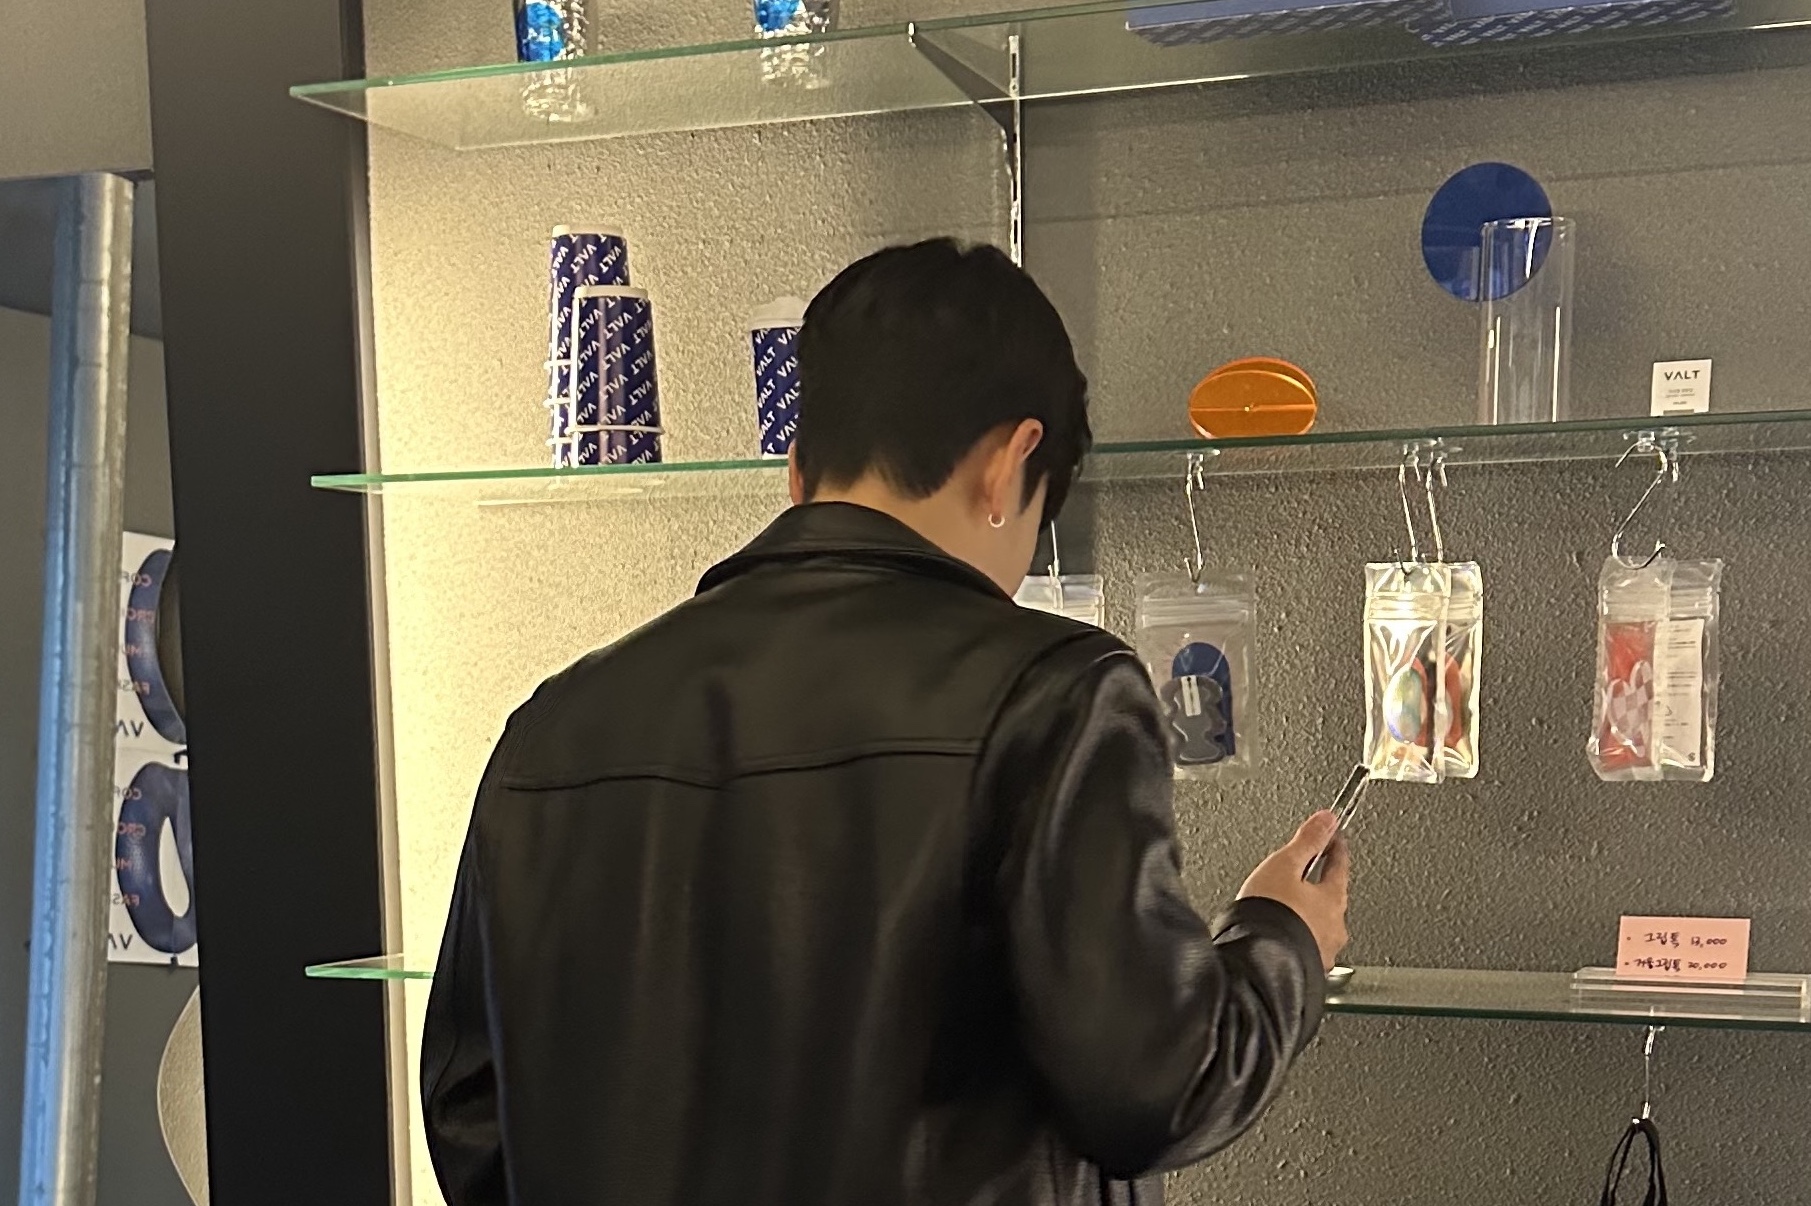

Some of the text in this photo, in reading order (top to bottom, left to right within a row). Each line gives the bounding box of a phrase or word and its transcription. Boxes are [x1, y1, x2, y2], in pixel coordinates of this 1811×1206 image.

[570, 243, 598, 274] VALT
[599, 245, 622, 273] VALT
[579, 308, 603, 339] VALT
[603, 312, 633, 340] VALT
[602, 343, 631, 371] VALT
[756, 346, 776, 376] VALT
[1664, 370, 1700, 381] VALT
[628, 380, 653, 406] VALT
[1687, 961, 1728, 971] 20,000
